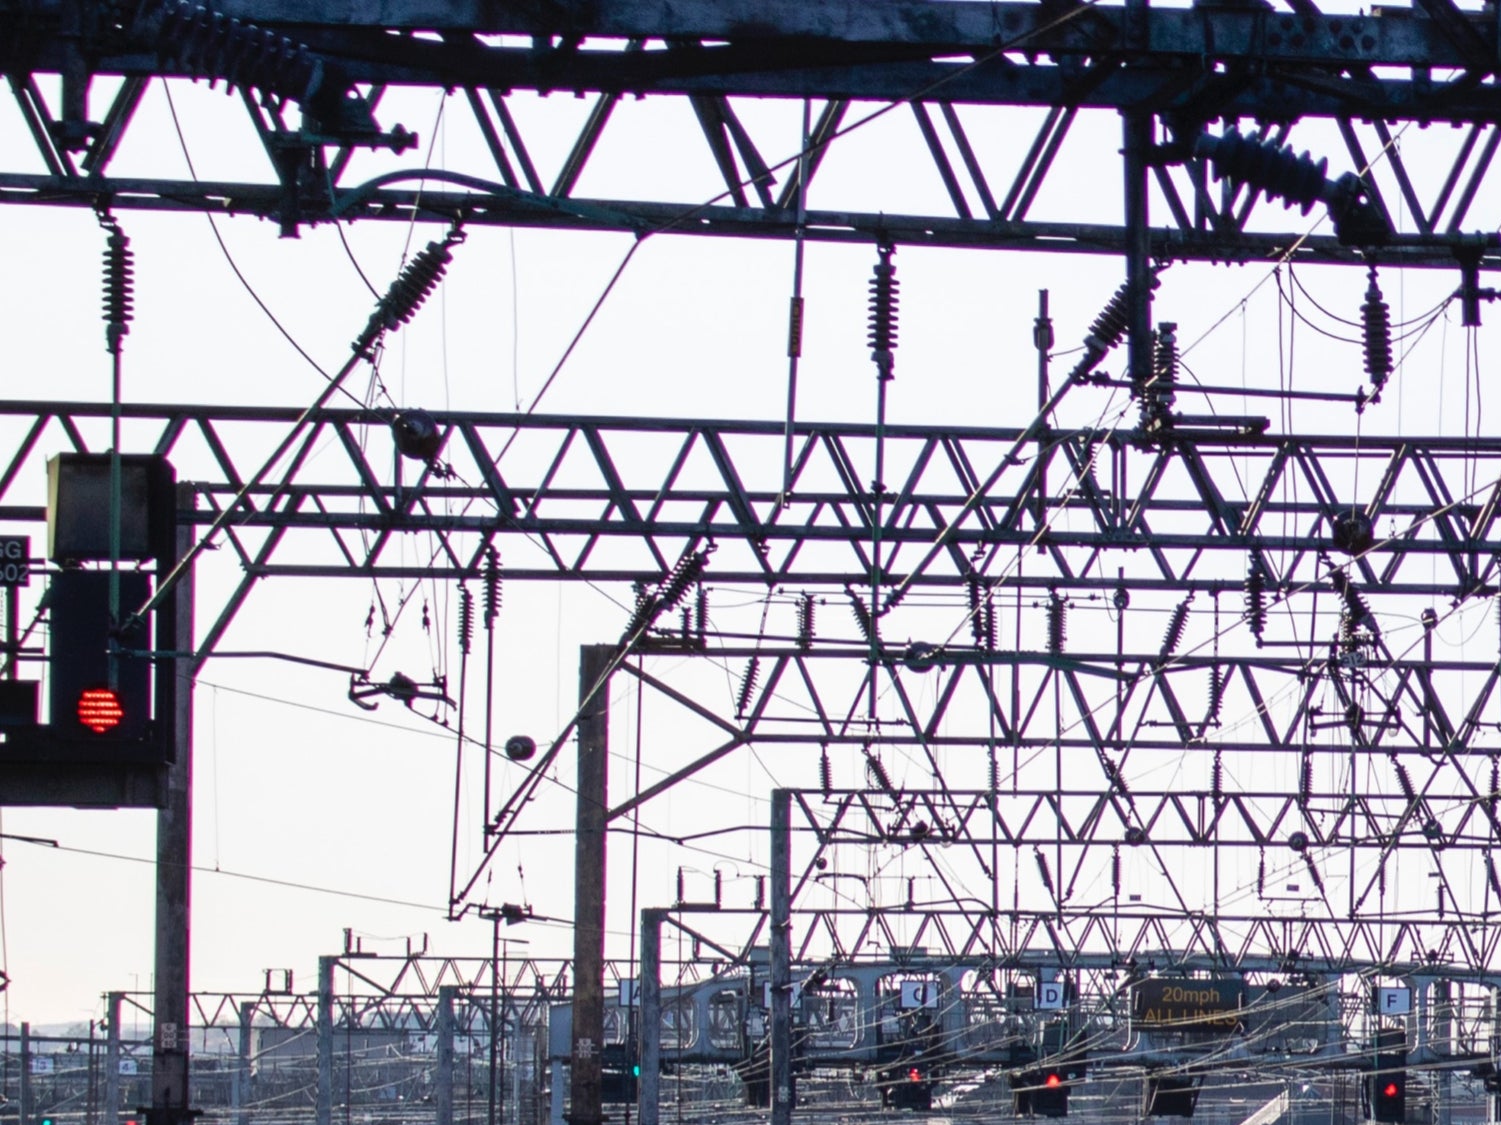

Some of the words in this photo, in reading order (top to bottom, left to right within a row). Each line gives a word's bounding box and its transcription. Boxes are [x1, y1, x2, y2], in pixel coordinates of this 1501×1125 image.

[0, 541, 22, 559] G
[0, 563, 30, 581] 02
[1046, 989, 1058, 1003] D
[1162, 986, 1220, 1005] 20mph
[1387, 994, 1398, 1008] F
[1144, 1008, 1172, 1023] ALL
[1183, 1008, 1238, 1025] LINES
